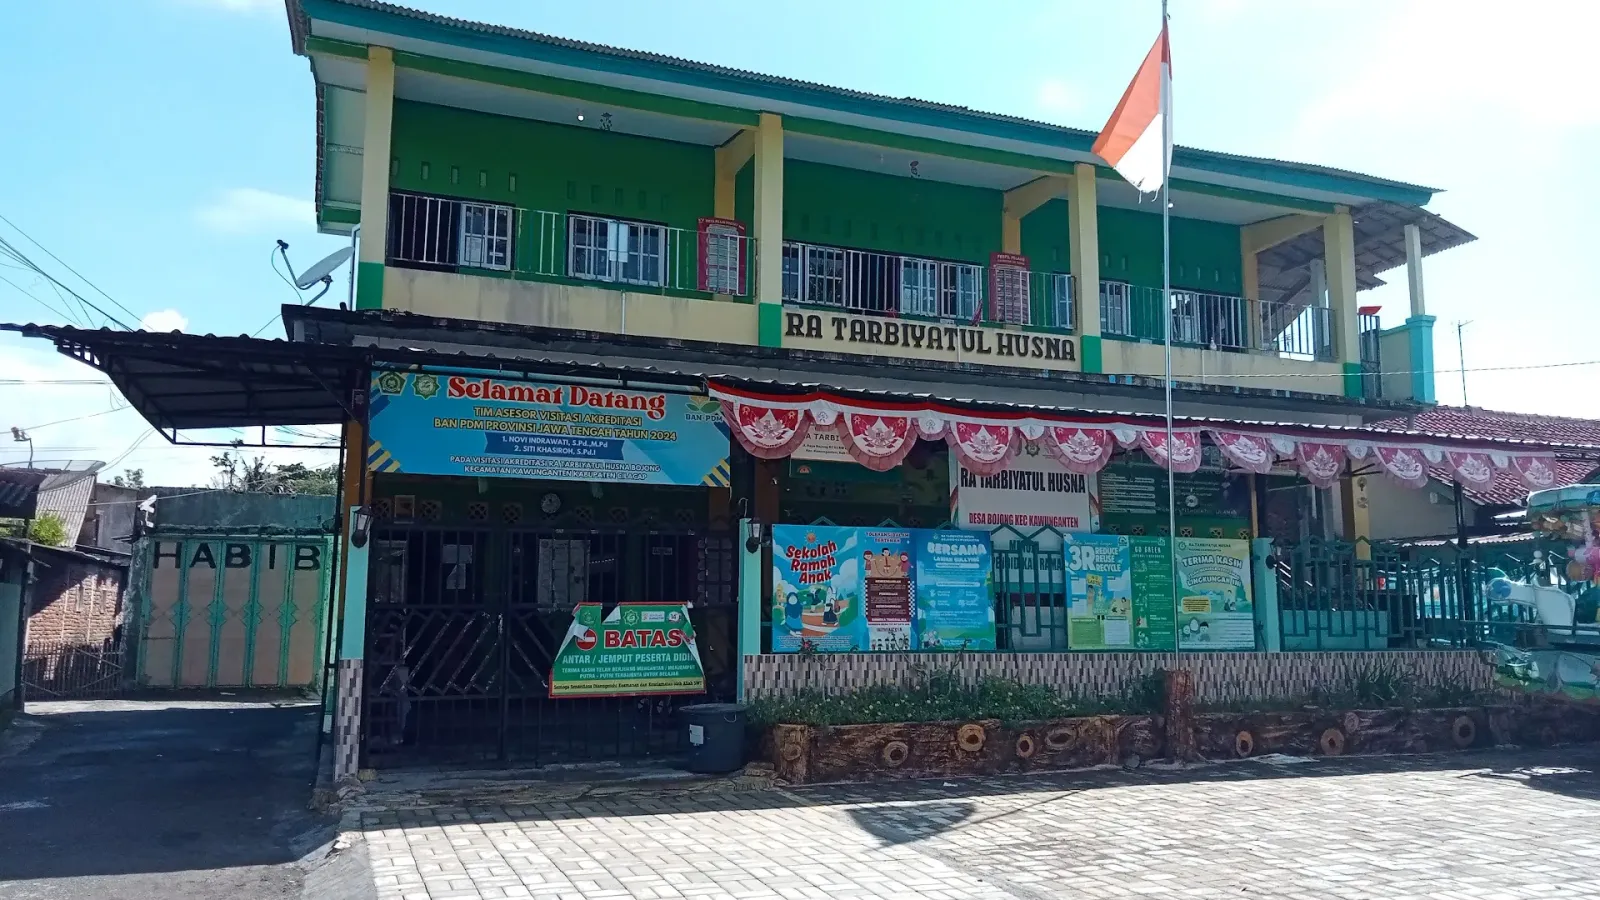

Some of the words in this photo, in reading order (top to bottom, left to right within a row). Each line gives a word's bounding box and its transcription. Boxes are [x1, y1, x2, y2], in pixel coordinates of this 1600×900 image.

[785, 312, 823, 338] RA
[832, 317, 991, 355] TARBIYATUL
[997, 332, 1076, 361] HUSNA
[448, 376, 562, 405] Selamat
[569, 385, 665, 420] Datang
[474, 406, 493, 417] TIM
[494, 408, 537, 419] ASESOR
[540, 410, 582, 423] VISITASI
[583, 412, 642, 427] AKREDITASI
[434, 418, 458, 429] BAN
[459, 419, 483, 430] PDM
[485, 420, 536, 433] PROVINSI
[538, 424, 569, 435] JAWA
[572, 426, 612, 438] TENGAH
[613, 428, 648, 440] TAHUN
[650, 431, 677, 441] 2024
[814, 433, 840, 441] TARBI
[508, 436, 528, 444] NOVI
[529, 437, 571, 447] INDRAWATI,
[523, 445, 536, 453] SITI
[473, 456, 503, 464] VISITASI
[504, 458, 547, 467] AKREDITASI
[562, 460, 605, 470] TARBIYATUL
[605, 462, 631, 471] HUSNA
[631, 464, 661, 472] BOJONG
[464, 465, 511, 475] KECAMATAN
[512, 467, 572, 478] KAWUNGANTEN
[573, 469, 616, 479] KABUPATEN
[960, 467, 976, 487] RA
[980, 469, 1045, 492] TARBIYATUL
[1048, 472, 1086, 493] HUSNA
[969, 512, 986, 525] DESA
[987, 513, 1013, 526] BOJONG
[1014, 514, 1028, 526] KEC
[1029, 515, 1079, 528] KAWUNGANTEN
[153, 541, 321, 570] HABIB
[786, 540, 837, 558] Sekolah
[927, 542, 987, 555] BERSAMA
[1095, 547, 1119, 555] REDUCE
[790, 555, 836, 572] Ramah
[1068, 545, 1096, 571] 3R
[1095, 555, 1115, 563] REUSE
[1182, 555, 1214, 567] TERIMA
[1216, 555, 1243, 569] KASIH
[1095, 563, 1122, 572] RECYCLE
[799, 570, 831, 583] Anak
[1187, 576, 1230, 587] LINGKUNGAN
[604, 629, 682, 648] BATAS
[562, 654, 590, 664] ANTAR
[592, 654, 596, 664] /
[598, 653, 632, 664] JEMPUT
[635, 652, 671, 662] PESERTA
